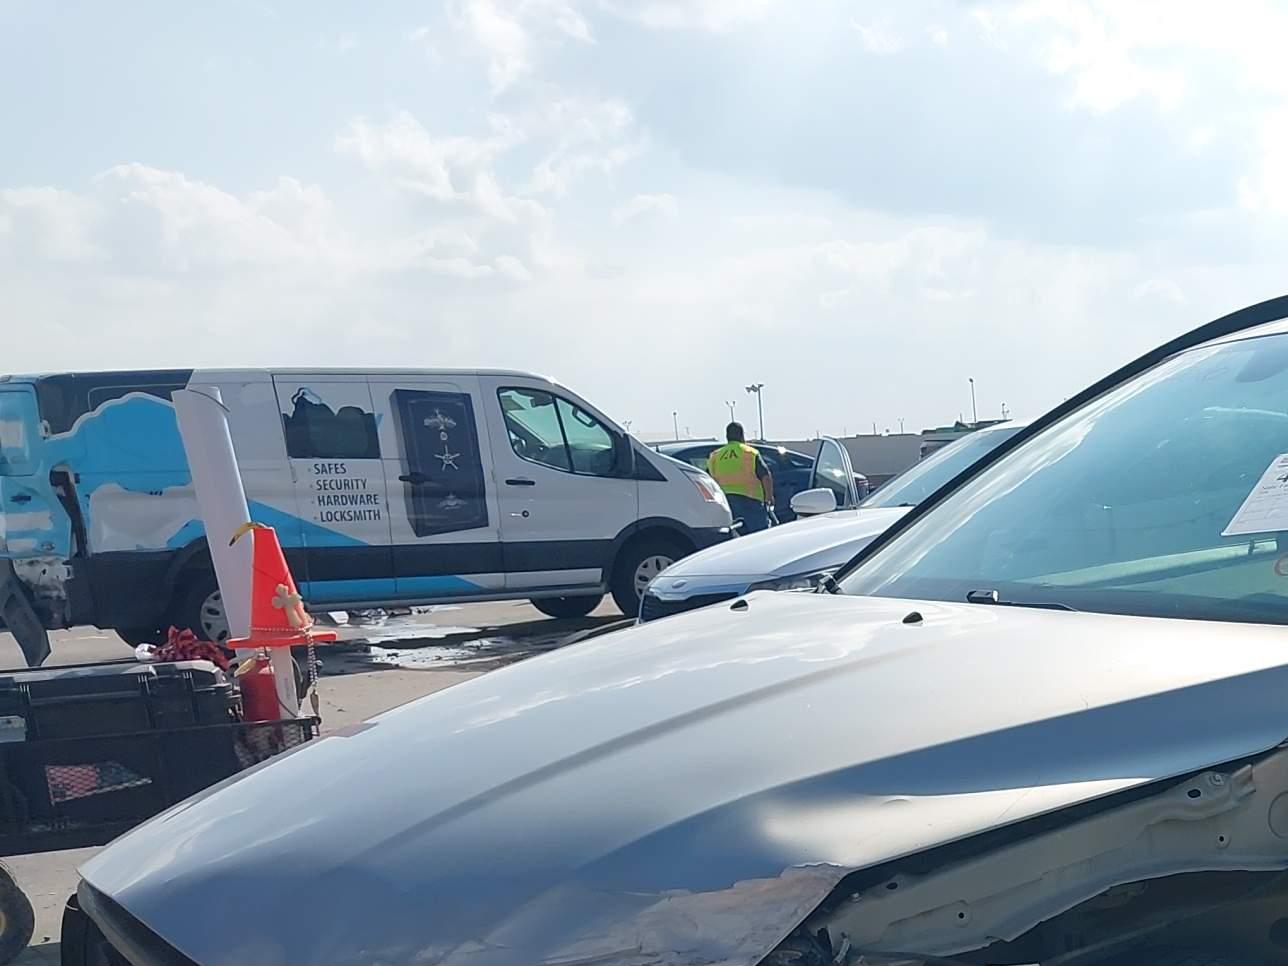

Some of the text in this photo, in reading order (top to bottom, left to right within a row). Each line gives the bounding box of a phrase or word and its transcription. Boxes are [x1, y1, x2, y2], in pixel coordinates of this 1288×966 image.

[313, 463, 347, 475] SAFES
[316, 479, 367, 491] SECURITY
[317, 494, 379, 506] HARDWARE
[320, 510, 381, 522] LOCKSMITH
